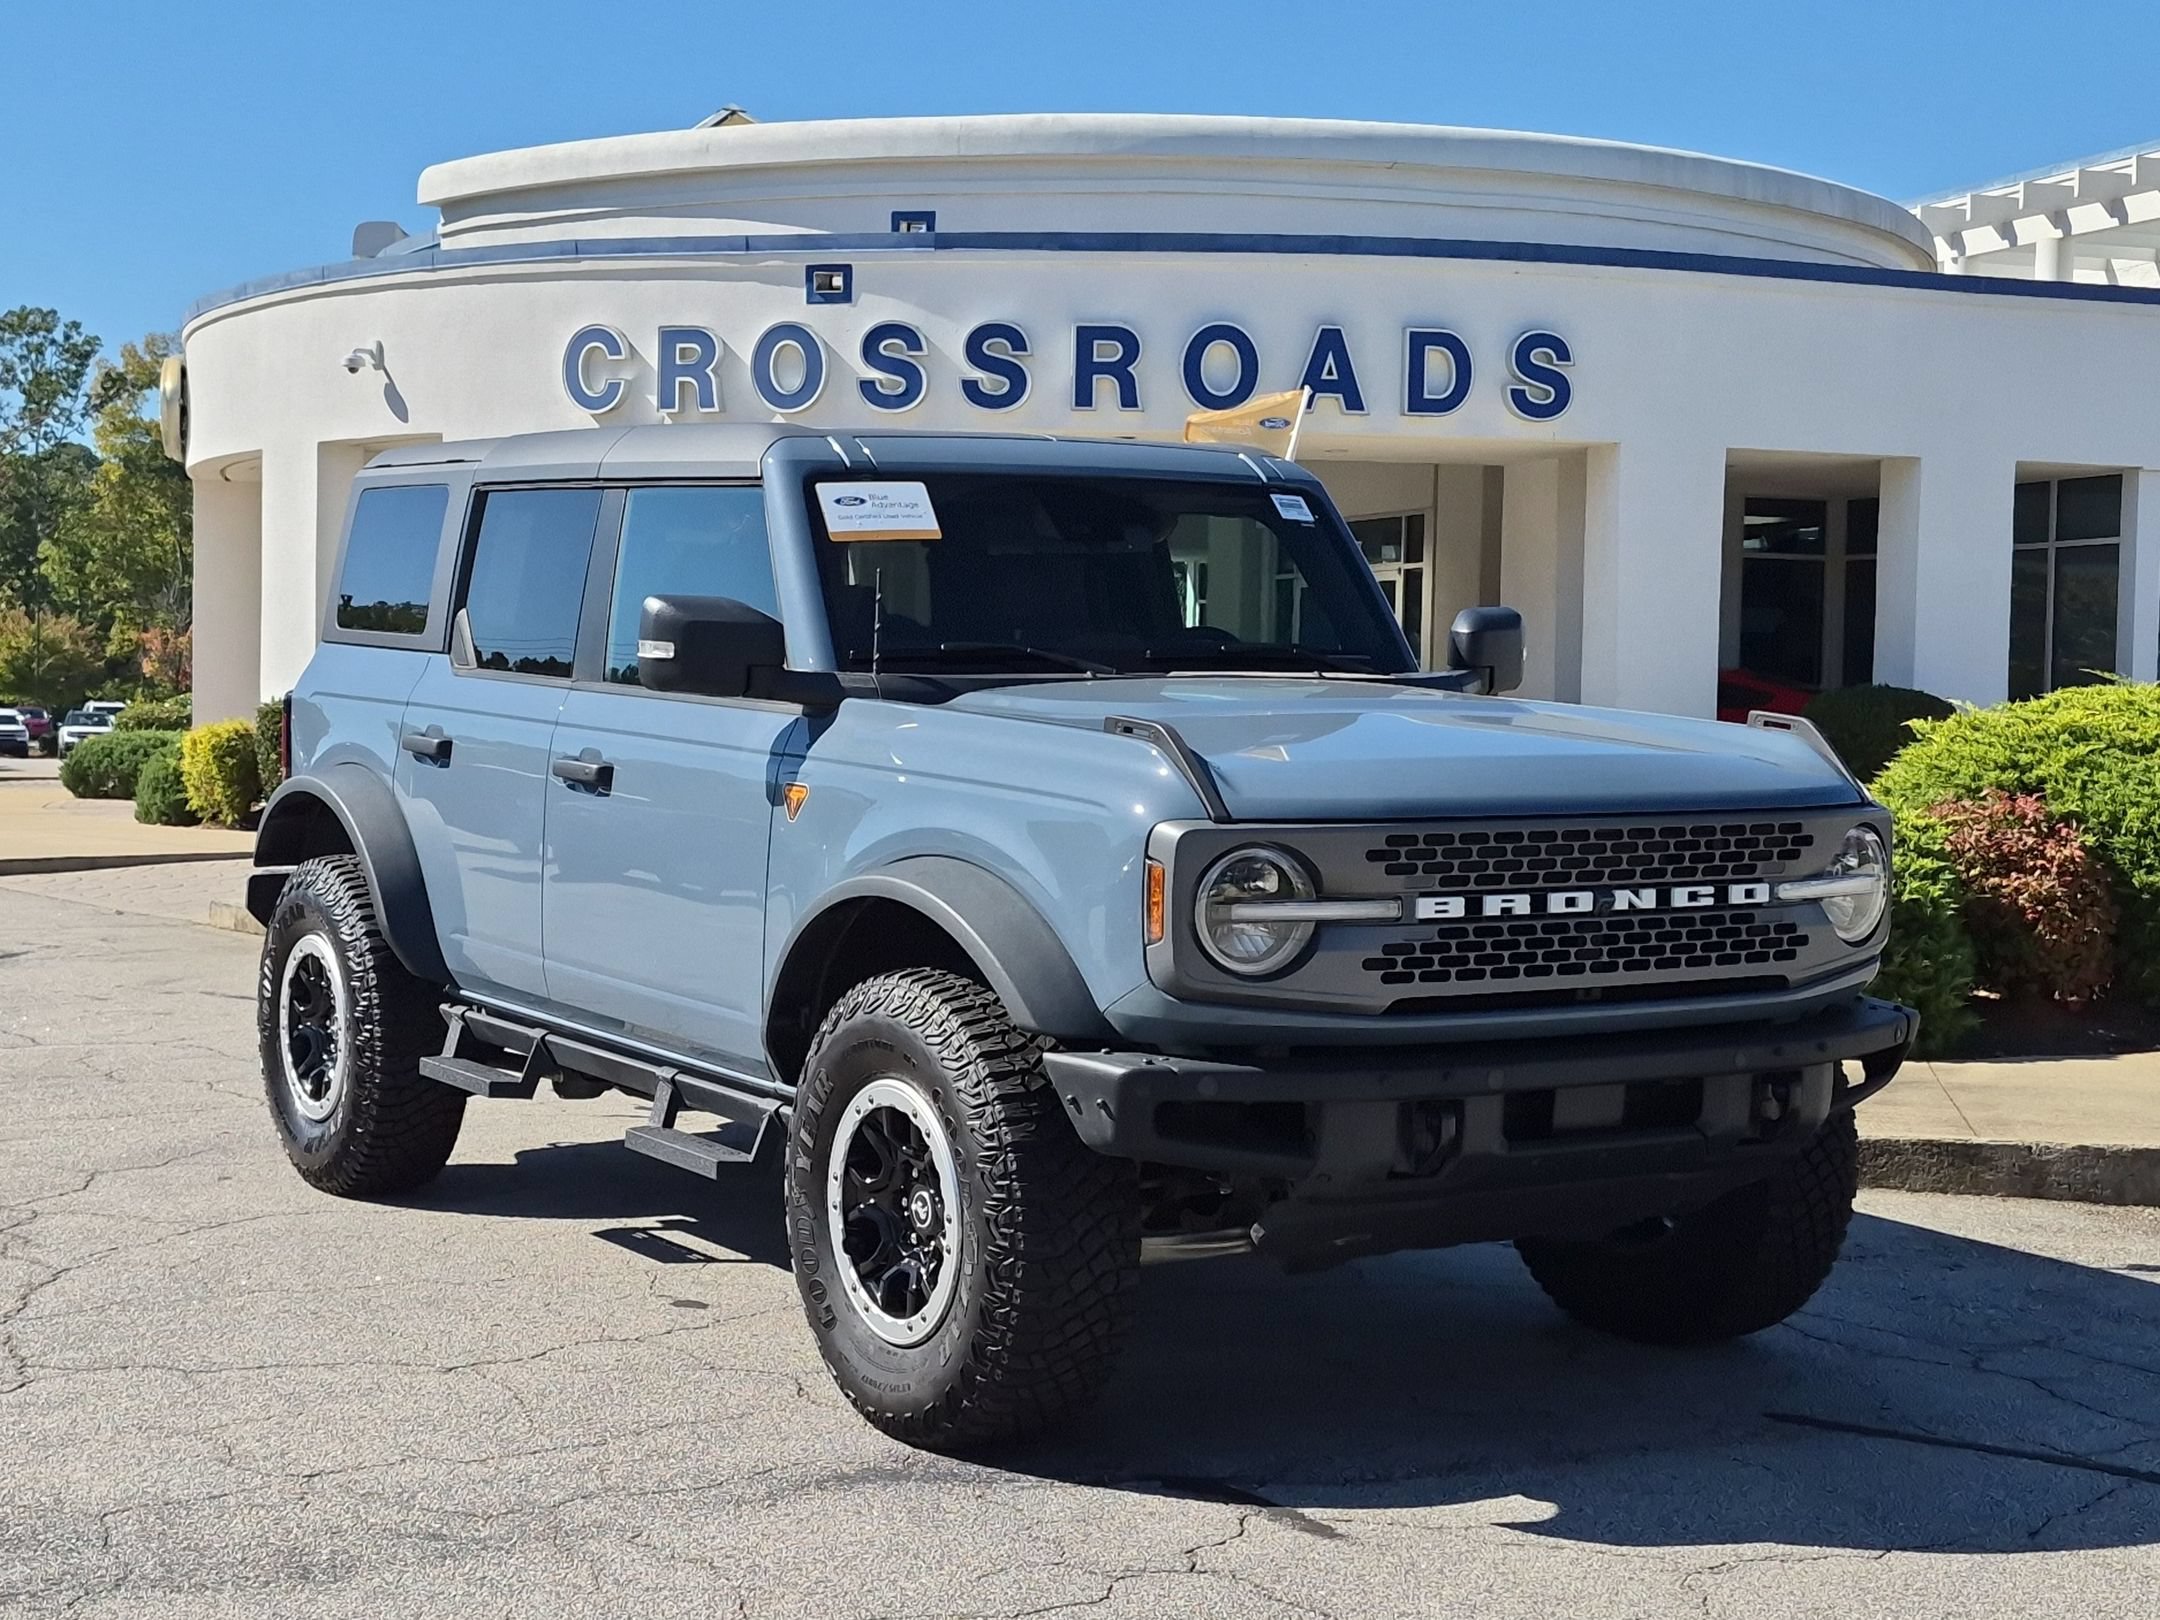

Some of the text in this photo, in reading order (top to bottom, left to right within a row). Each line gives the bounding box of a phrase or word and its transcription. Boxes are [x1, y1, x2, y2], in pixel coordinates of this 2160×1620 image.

[563, 320, 1576, 421] CROSSROADS
[868, 493, 888, 501] Blue
[871, 501, 919, 509] Advantage
[1415, 883, 1771, 920] BRONCO
[791, 1068, 837, 1332] GOODYEAR
